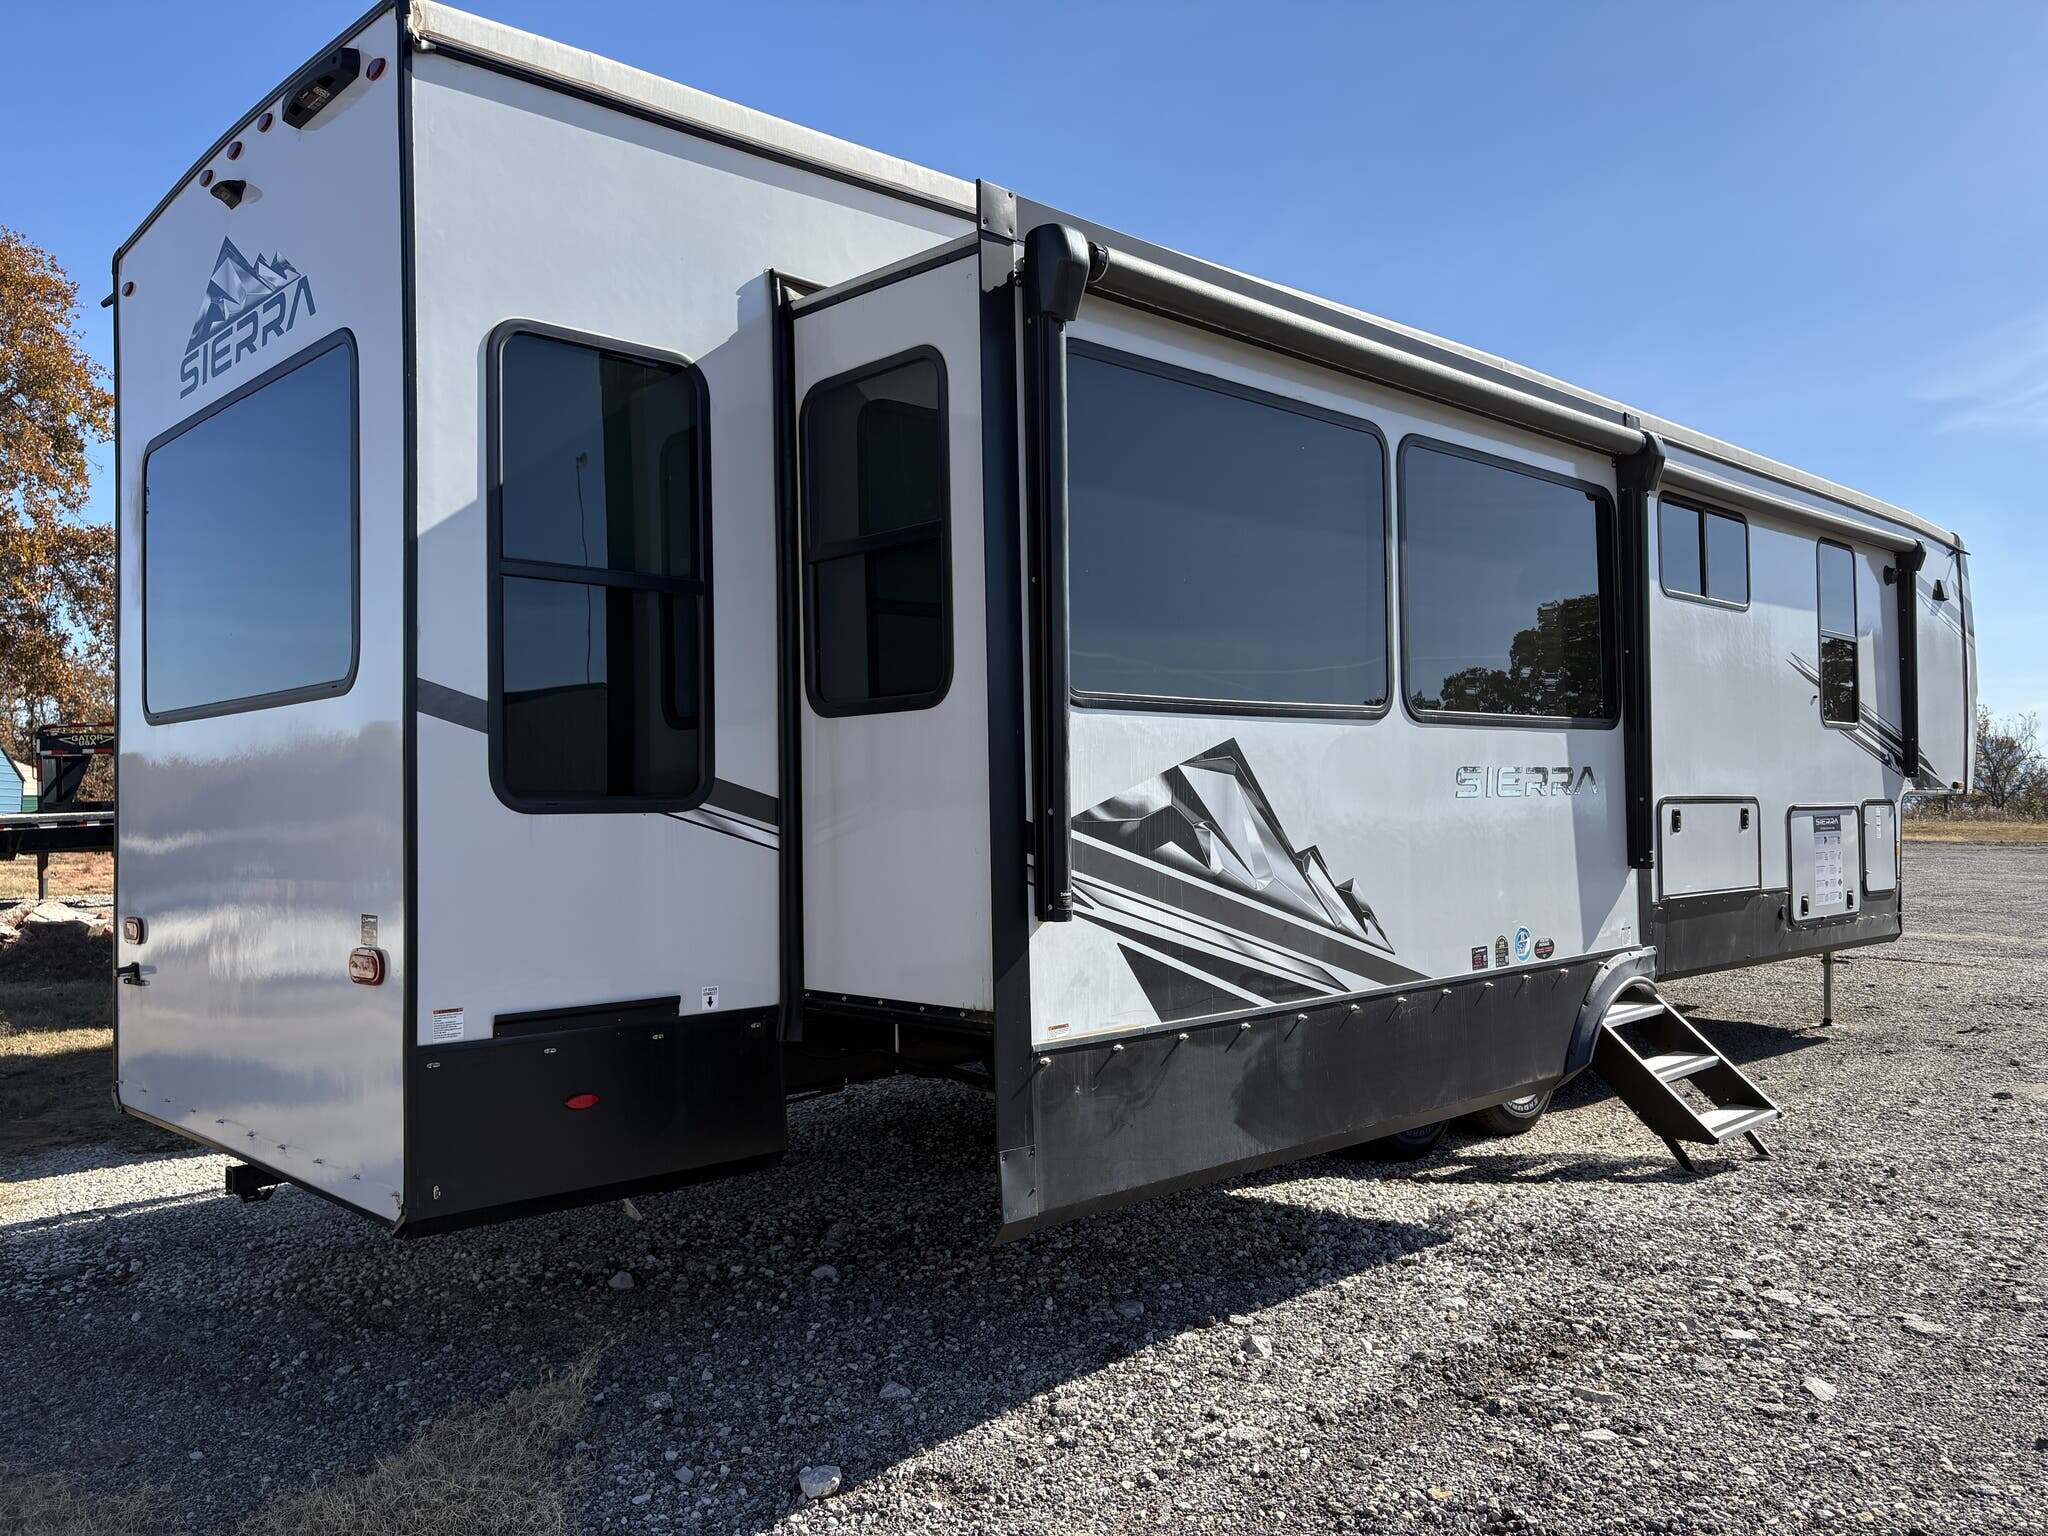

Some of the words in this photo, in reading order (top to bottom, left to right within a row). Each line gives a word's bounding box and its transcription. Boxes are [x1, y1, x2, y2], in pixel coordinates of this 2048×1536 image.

[179, 275, 317, 400] SIERRA
[71, 734, 104, 742] GATOR
[1455, 765, 1599, 799] SIERRA
[1815, 818, 1839, 826] SIERRA
